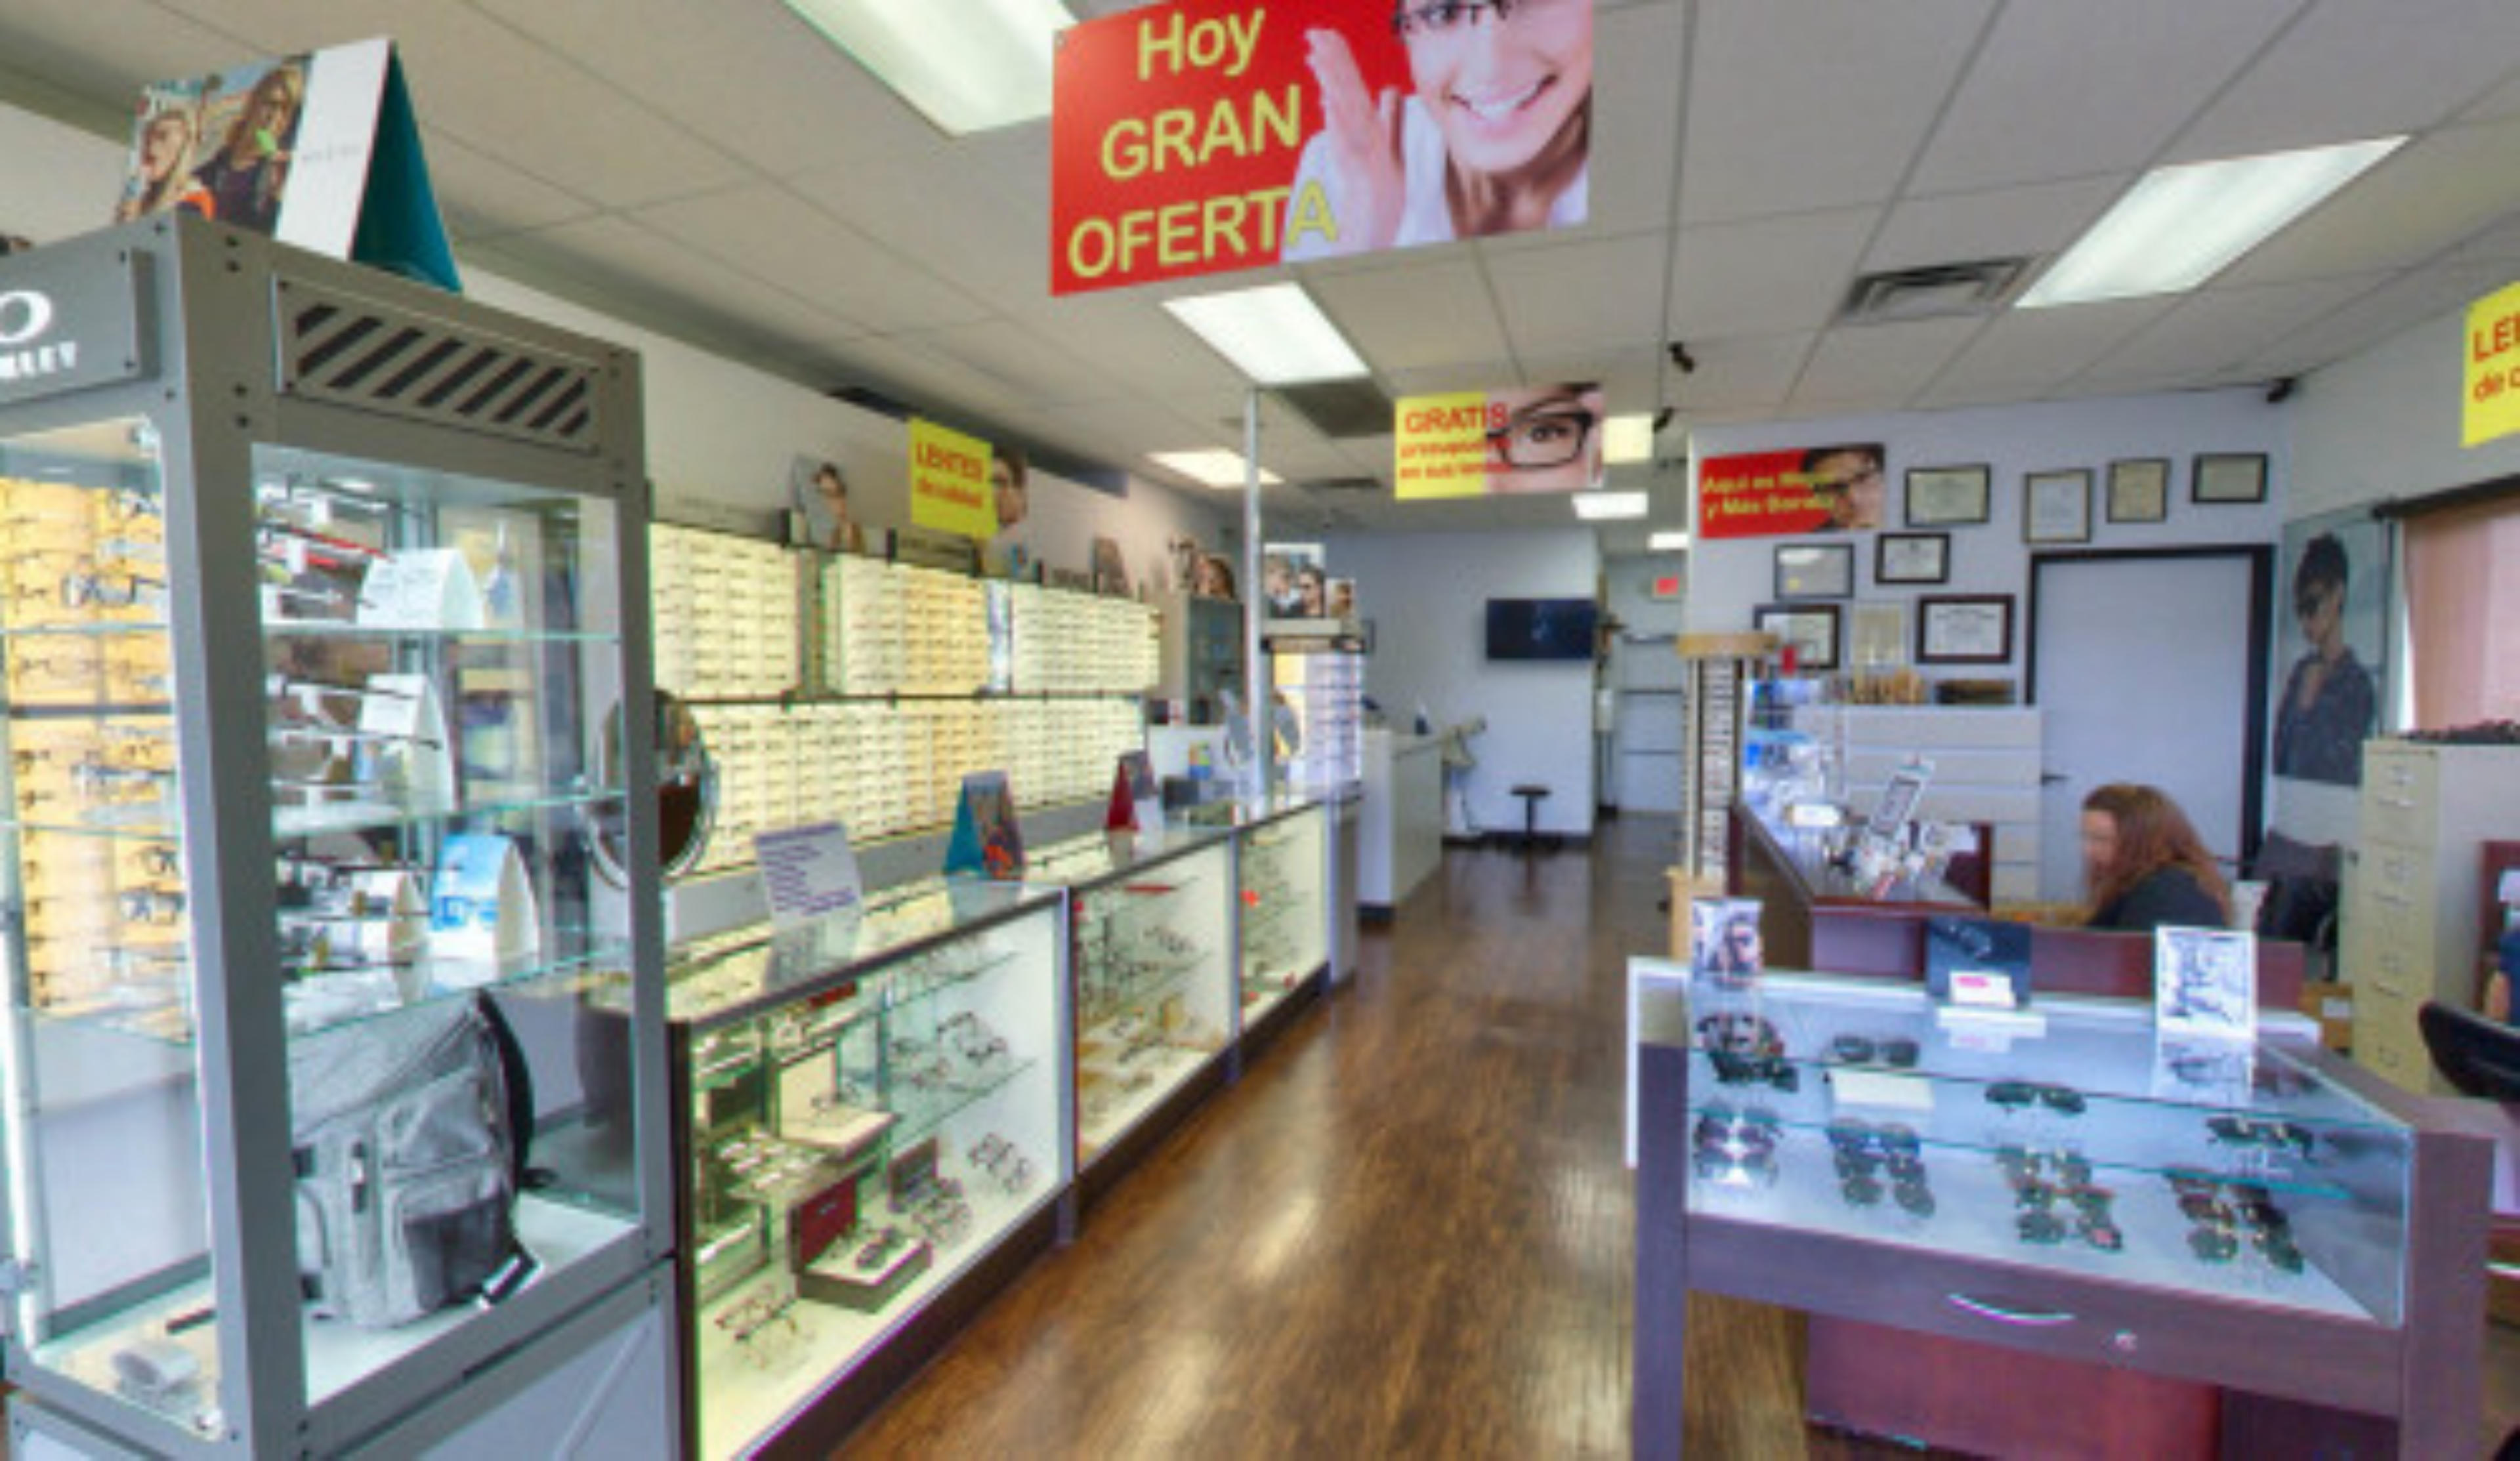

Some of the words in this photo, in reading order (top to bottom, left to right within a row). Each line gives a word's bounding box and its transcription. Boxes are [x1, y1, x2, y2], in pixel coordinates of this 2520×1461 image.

[1137, 8, 1266, 81] Hoy
[1101, 83, 1301, 182] GRAN
[1067, 180, 1338, 278] OFERTA
[1405, 401, 1507, 434] GRATIS
[2473, 371, 2504, 405] de
